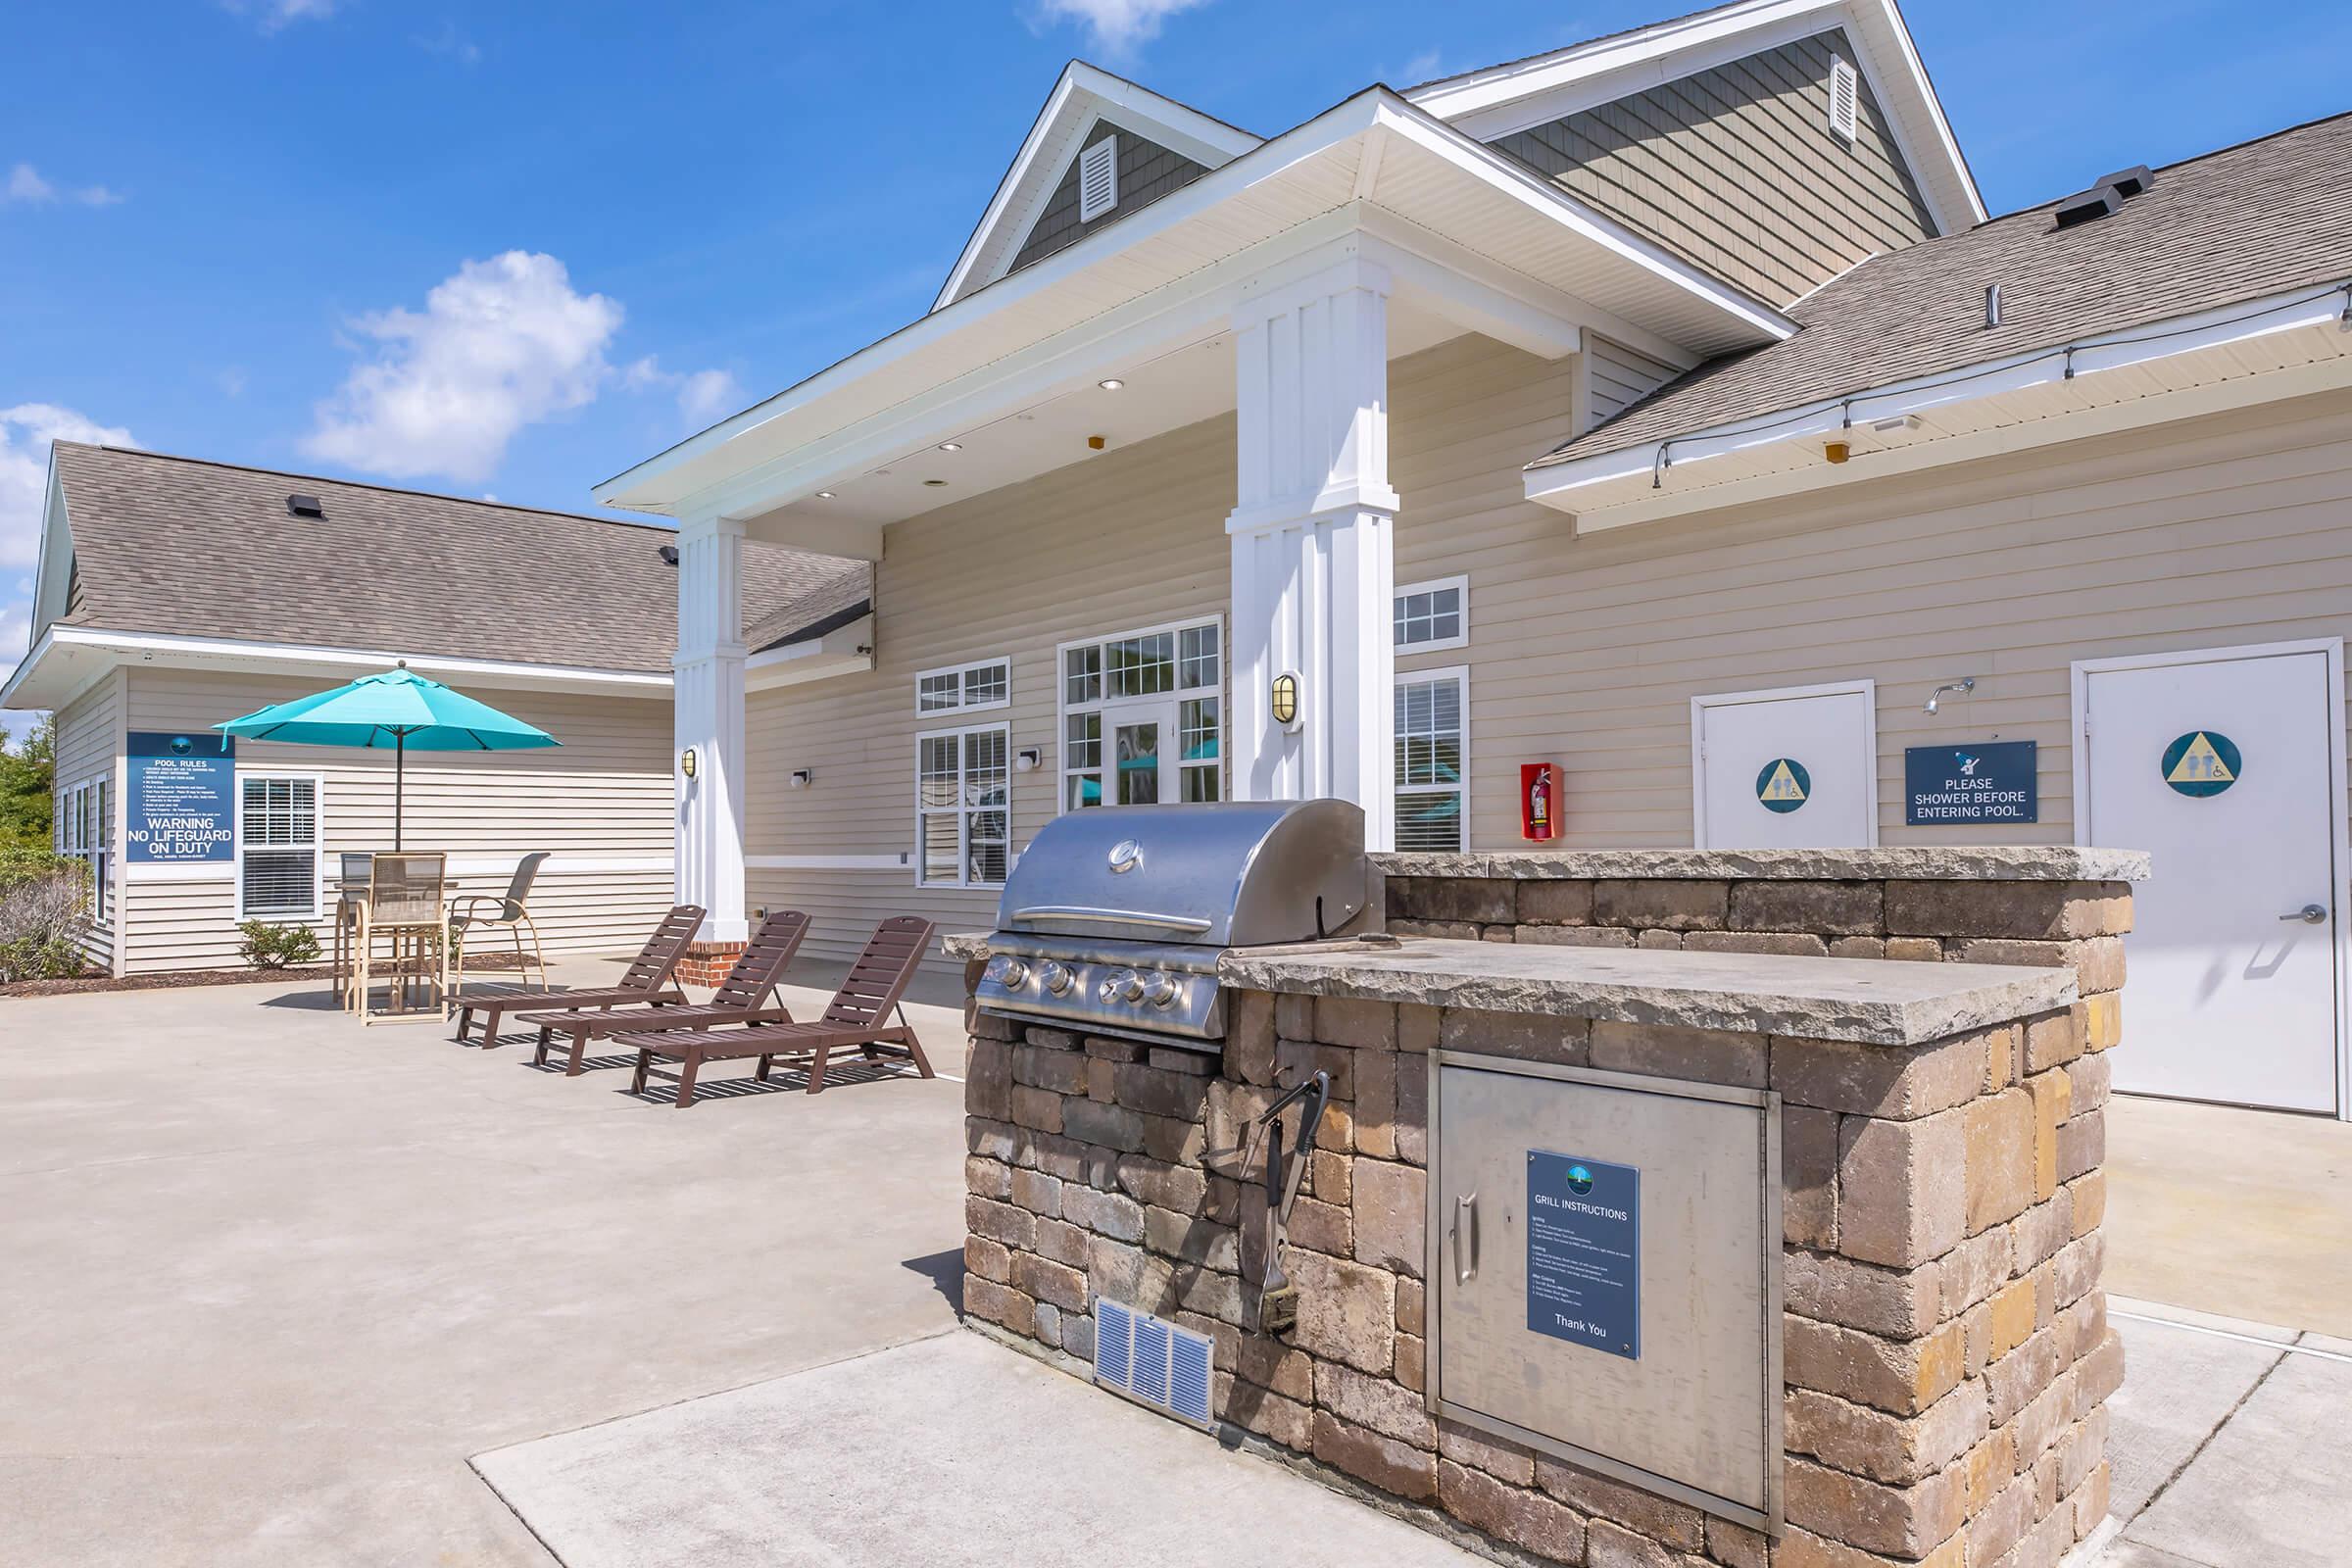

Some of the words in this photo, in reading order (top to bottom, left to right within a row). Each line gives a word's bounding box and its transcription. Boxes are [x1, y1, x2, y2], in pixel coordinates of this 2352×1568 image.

[1945, 778, 1993, 790] PLEASE
[1915, 793, 1970, 805] SHOWER
[1974, 791, 2026, 804] BEFORE
[1917, 807, 1981, 818] ENTERING
[1984, 806, 2024, 816] POOL.
[147, 817, 214, 829] WARNING
[127, 830, 149, 842] NO
[155, 830, 232, 842] LIFEGUARD
[149, 842, 170, 854] ON
[175, 842, 213, 854] DUTY
[1535, 1194, 1560, 1207] GRILL
[1561, 1199, 1628, 1221] INSTRUCTIONS
[1554, 1313, 1586, 1332] Thank
[1588, 1323, 1606, 1338] You
